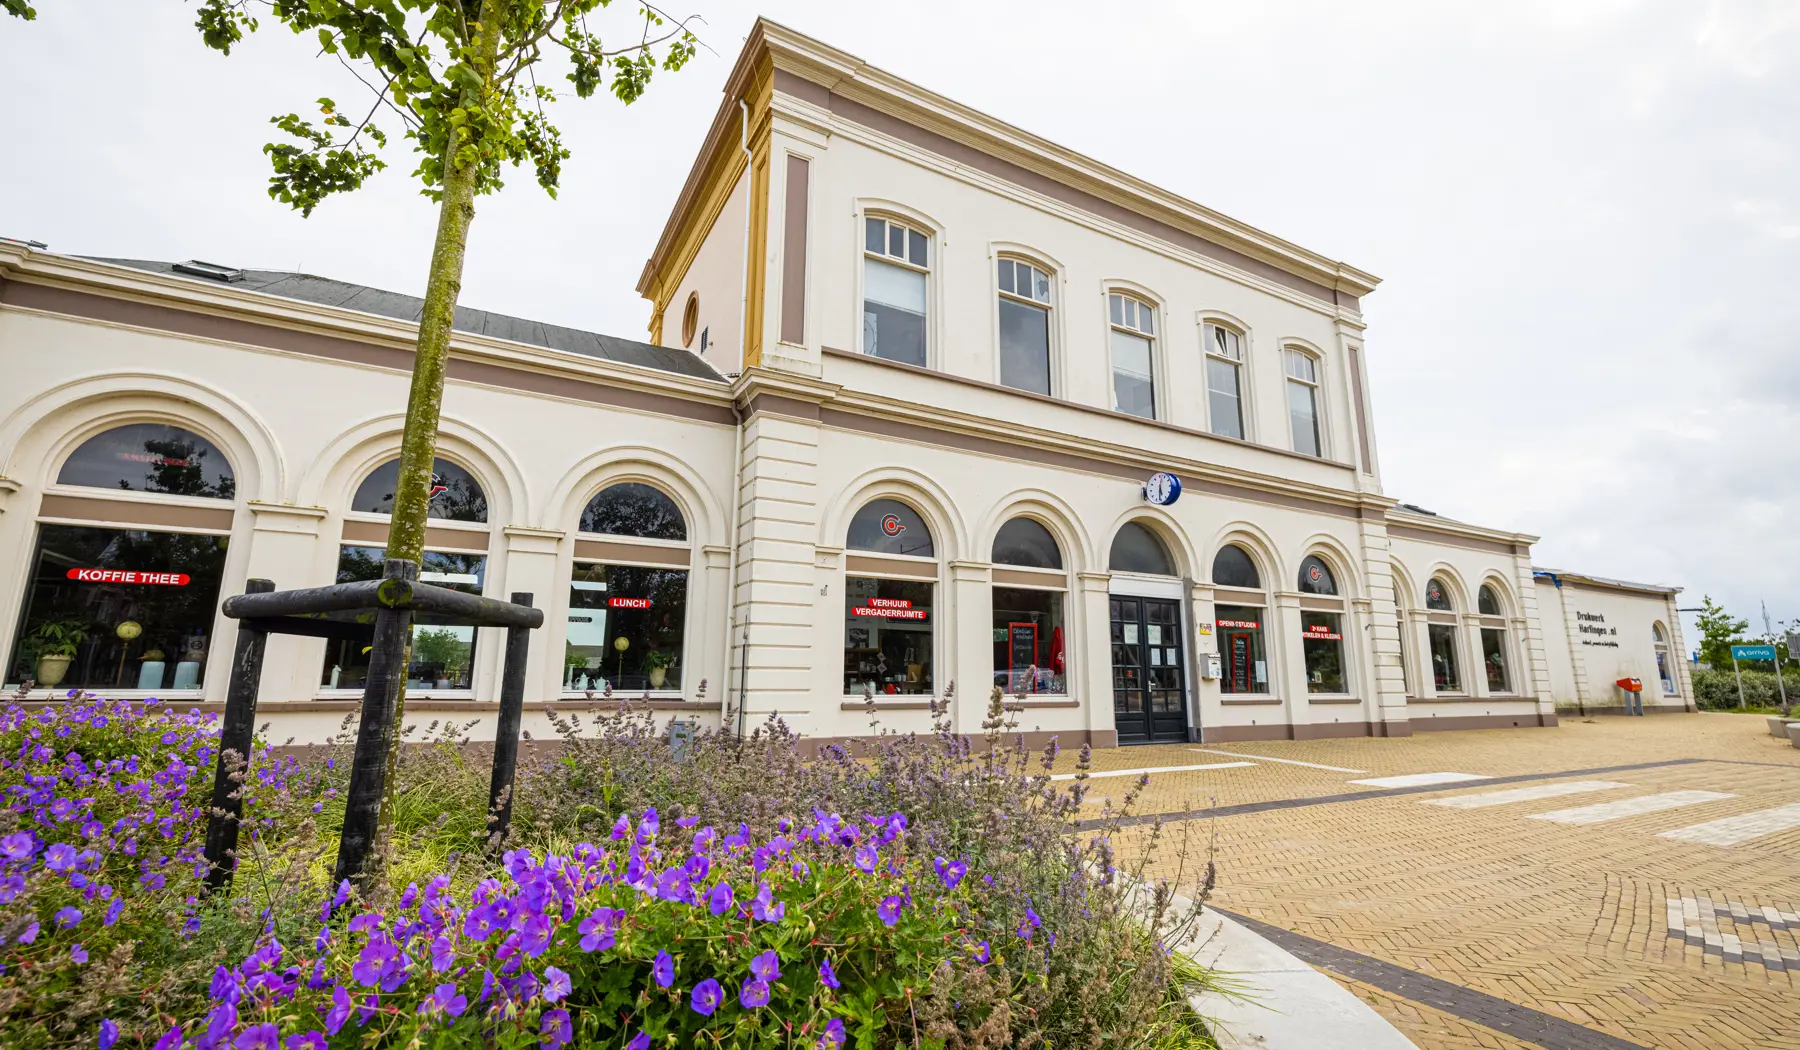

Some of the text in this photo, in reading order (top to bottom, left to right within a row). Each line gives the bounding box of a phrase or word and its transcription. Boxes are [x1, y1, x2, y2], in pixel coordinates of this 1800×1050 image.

[78, 570, 180, 584] KOFFIE THEE
[613, 599, 646, 608] LUNCH
[872, 599, 908, 608] VERHUUR
[855, 607, 923, 619] VERGADERRUIMTE
[1576, 611, 1605, 622] Drukwerk
[1579, 624, 1607, 637] Harlingen
